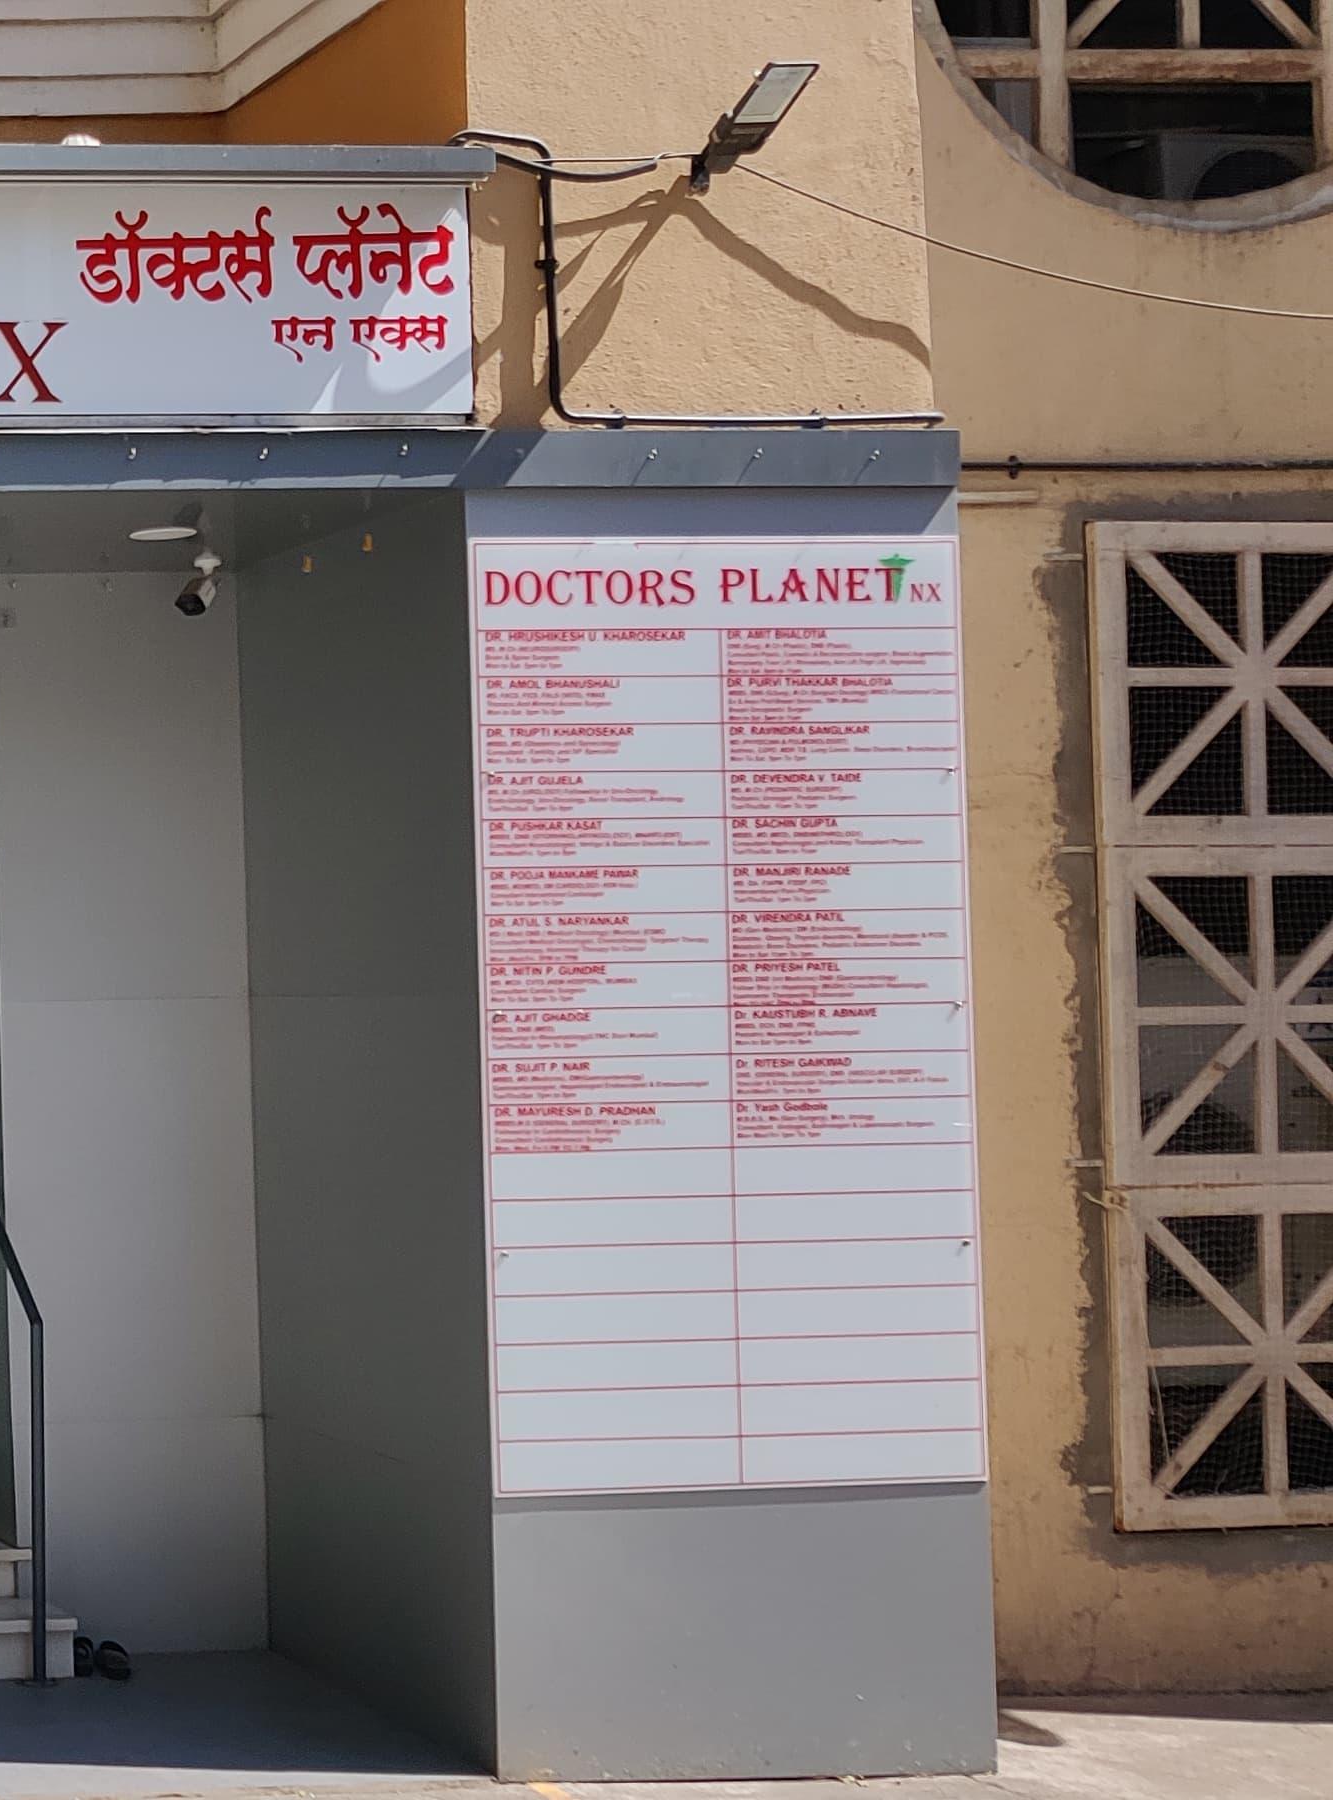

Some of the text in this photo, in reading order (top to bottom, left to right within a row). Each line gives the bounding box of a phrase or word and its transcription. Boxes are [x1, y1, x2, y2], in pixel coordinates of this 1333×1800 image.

[271, 314, 448, 362] एन एक्स
[484, 568, 941, 607] DOCTORS PLANET NX
